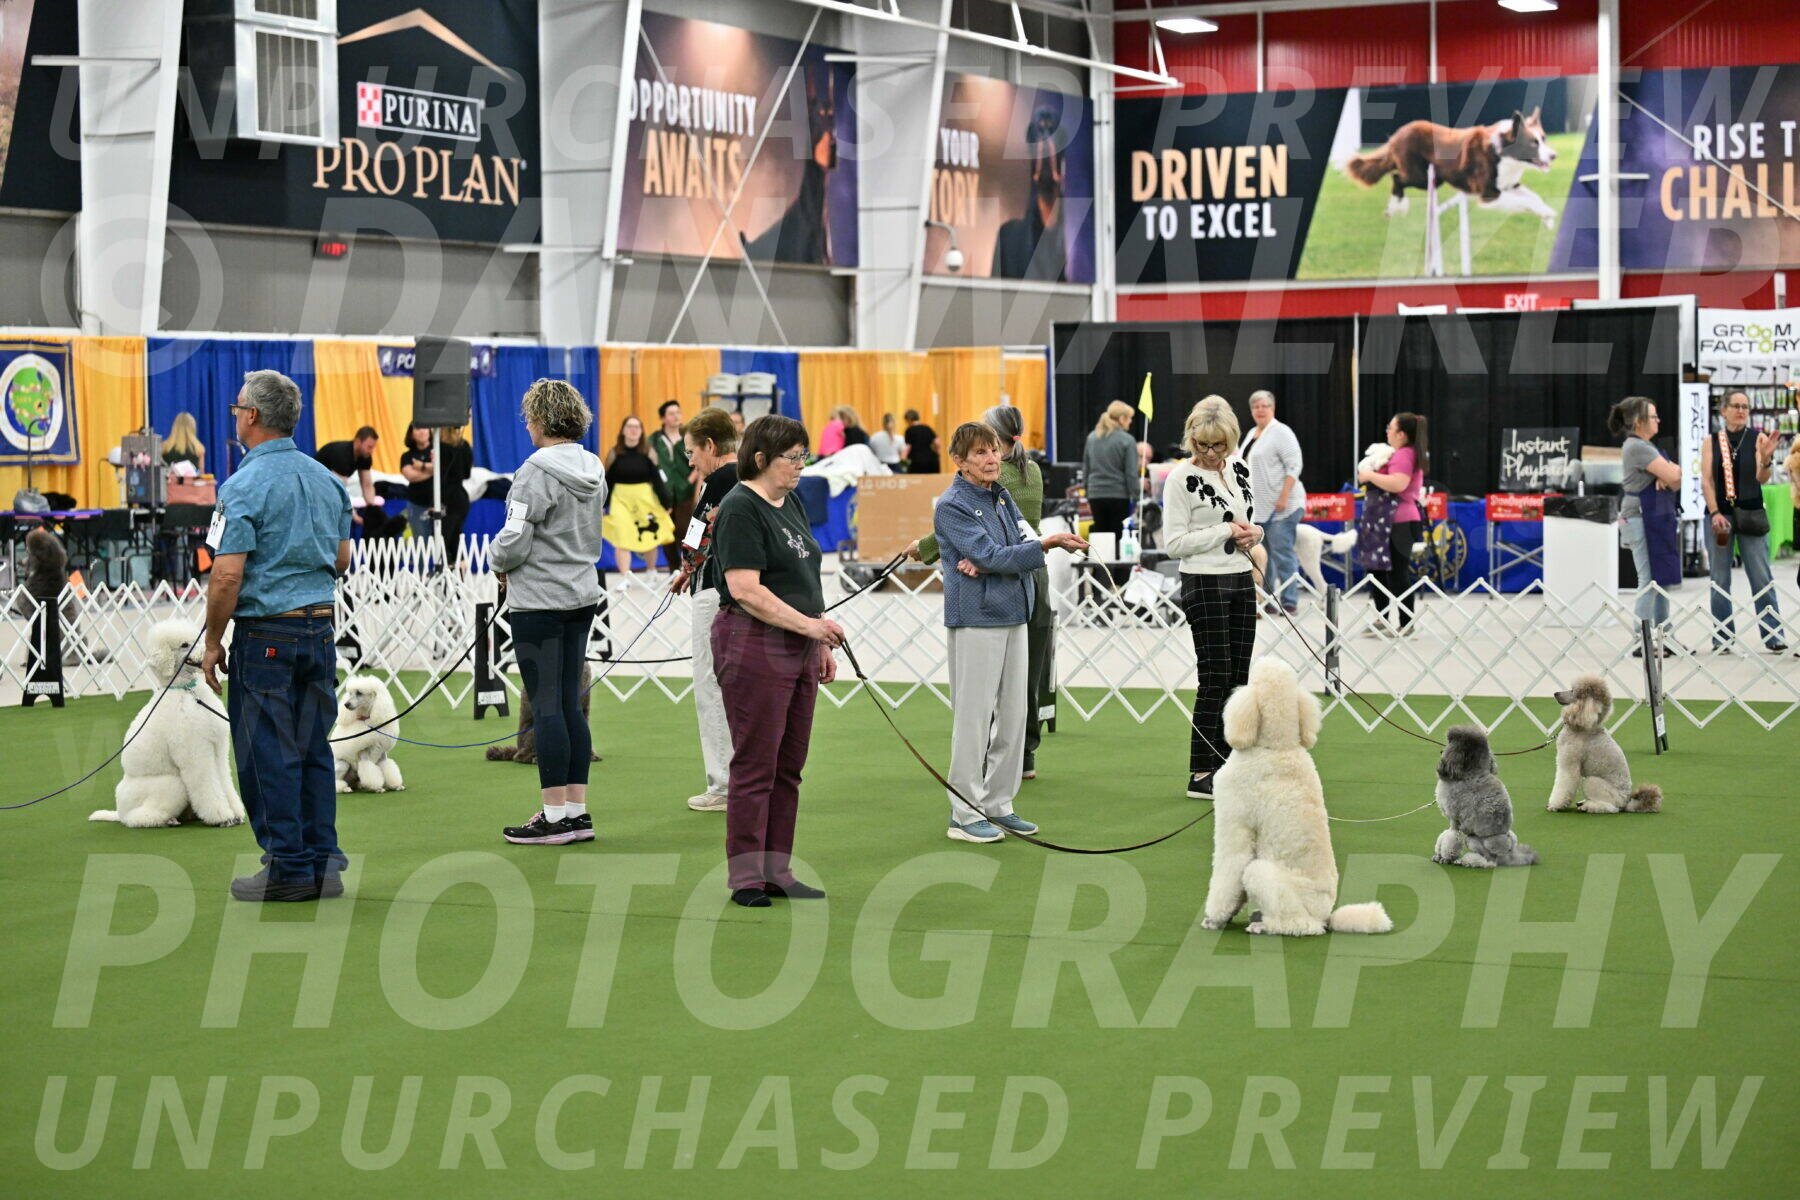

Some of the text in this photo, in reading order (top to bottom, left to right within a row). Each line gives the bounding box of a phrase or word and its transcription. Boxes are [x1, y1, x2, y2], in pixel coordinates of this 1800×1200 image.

[384, 92, 477, 135] PURINA
[629, 77, 757, 137] OPPORTUNITY
[940, 126, 980, 169] YOUR
[1693, 120, 1800, 160] RISE T
[312, 137, 521, 206] PRO PLAN
[643, 128, 743, 202] AWAITS
[1131, 144, 1288, 202] DRIVEN
[1142, 202, 1277, 241] TO EXCEL
[1504, 293, 1538, 312] EXIT
[1700, 338, 1800, 354] FACTORY
[1713, 323, 1792, 340] GROOM
[1511, 428, 1571, 455] Instant
